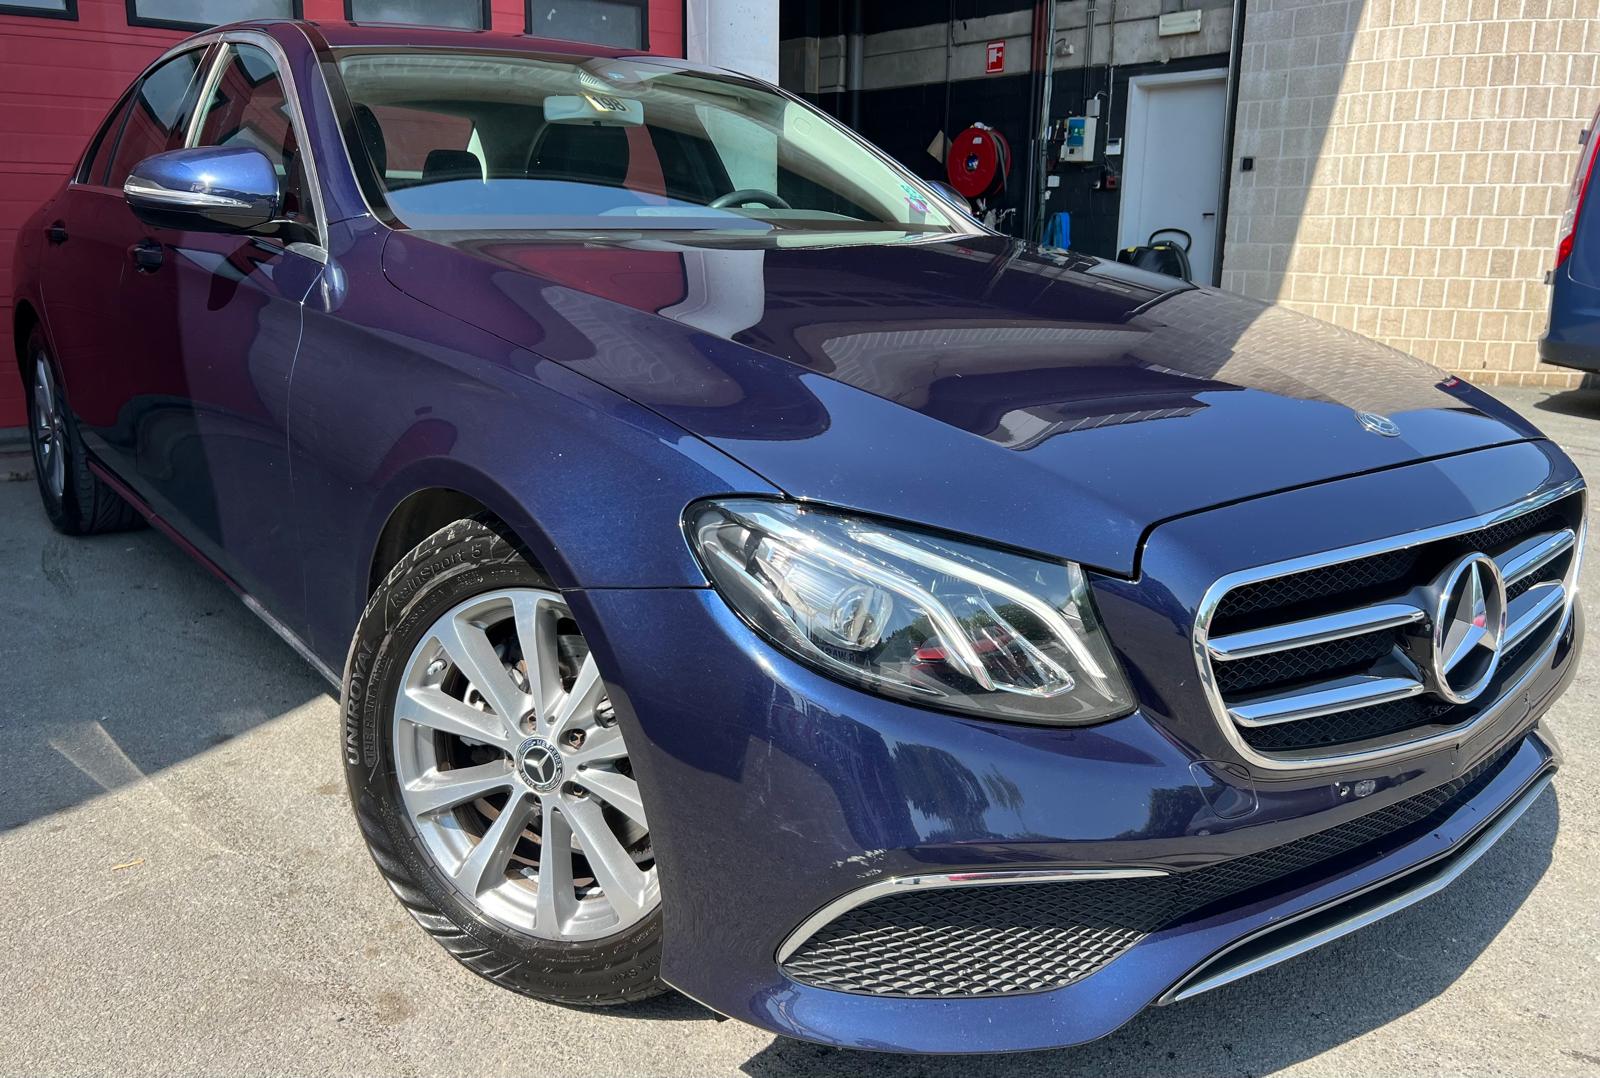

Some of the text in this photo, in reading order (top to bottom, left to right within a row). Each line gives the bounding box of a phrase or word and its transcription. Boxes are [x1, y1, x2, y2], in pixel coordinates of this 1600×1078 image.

[592, 96, 626, 111] 198
[471, 544, 482, 559] 5
[347, 639, 374, 766] UNIROYAL
[363, 734, 376, 761] THE
[536, 740, 562, 768] MERCEDES
[520, 771, 535, 787] BENZ
